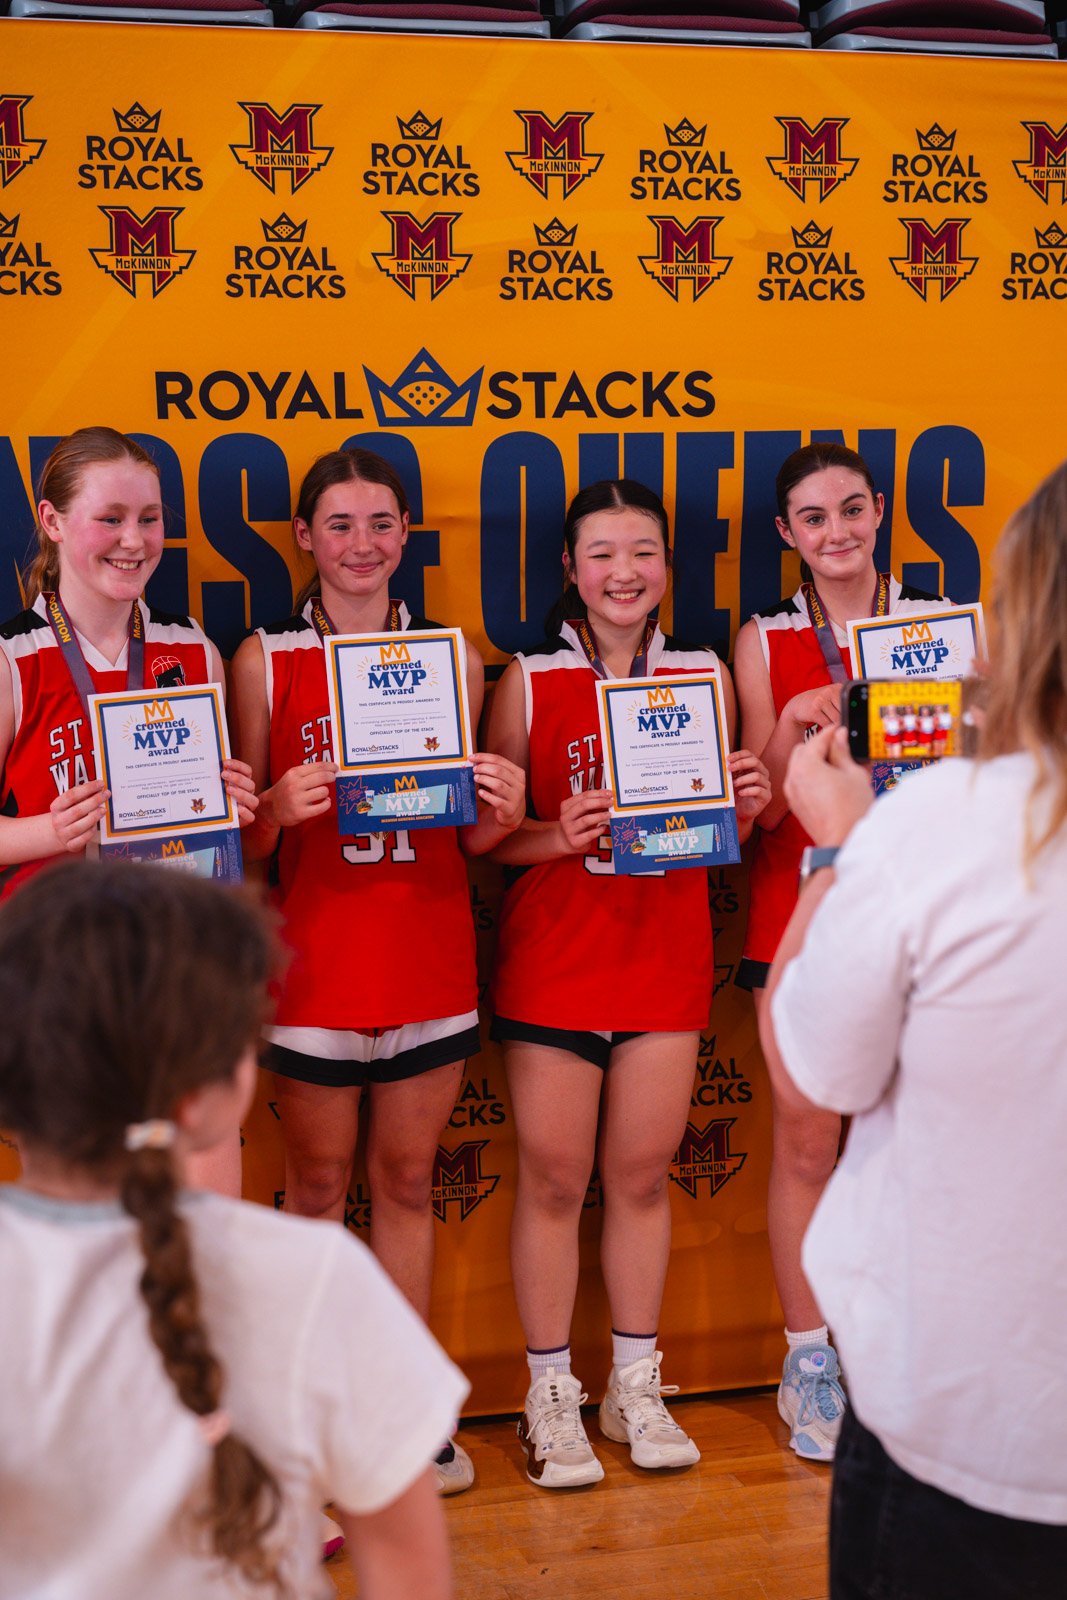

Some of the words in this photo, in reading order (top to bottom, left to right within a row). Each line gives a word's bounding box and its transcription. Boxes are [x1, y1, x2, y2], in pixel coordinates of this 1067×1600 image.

[86, 136, 193, 162] ROYAL
[372, 143, 470, 169] ROYAL
[255, 154, 309, 166] McKINNON
[529, 160, 581, 172] McKINNON
[640, 150, 733, 174] ROYAL
[893, 154, 980, 177] ROYAL
[78, 164, 203, 191] STACKS
[788, 165, 837, 177] McKINNON
[363, 171, 480, 197] STACKS
[631, 176, 741, 201] STACKS
[883, 180, 987, 203] STACKS
[115, 257, 171, 269] McKINNON
[235, 246, 336, 270] ROYAL
[396, 261, 449, 273] McKINNON
[509, 250, 604, 273] ROYAL
[767, 252, 857, 275] ROYAL
[1011, 252, 1067, 274] ROY
[661, 264, 711, 276] McKINNON
[910, 265, 957, 276] McKINNON
[226, 274, 346, 298] STACKS
[499, 277, 613, 300] STACKS
[758, 278, 864, 301] STACKS
[155, 370, 362, 420] ROYAL
[487, 371, 715, 419] STACKS
[893, 638, 944, 652] crowned
[370, 660, 422, 672] crowned
[891, 646, 949, 670] MVP
[368, 670, 426, 689] MVP
[905, 664, 938, 676] award
[382, 686, 414, 696] award
[639, 704, 686, 715] crowned
[135, 718, 186, 732] crowned
[637, 712, 690, 732] MVP
[133, 727, 190, 750] MVP
[650, 730, 680, 739] award
[148, 746, 180, 757] award
[388, 789, 426, 798] crowned
[385, 797, 430, 812] MVP
[660, 829, 695, 838] crowned
[658, 836, 699, 851] MVP
